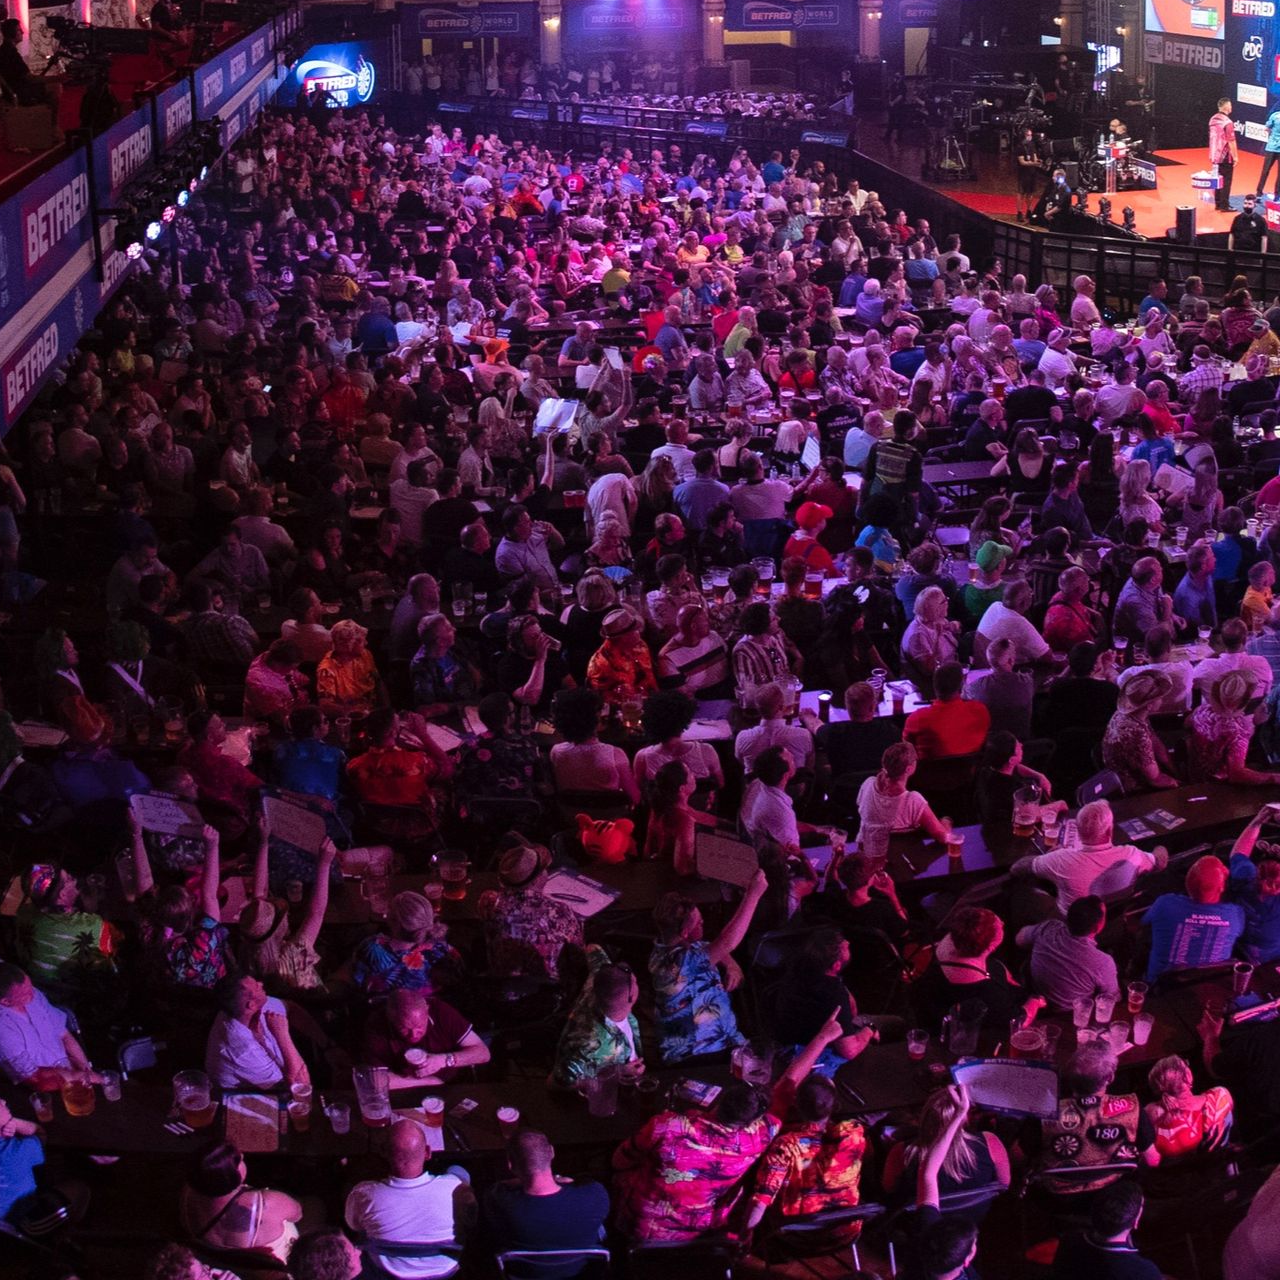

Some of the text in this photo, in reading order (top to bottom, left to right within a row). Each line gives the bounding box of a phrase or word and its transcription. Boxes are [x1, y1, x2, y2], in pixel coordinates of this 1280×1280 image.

[1164, 40, 1222, 69] BETFRED
[305, 75, 357, 94] BTFRED
[27, 172, 90, 268] BETFRED
[6, 321, 59, 415] BETFRED
[1080, 1096, 1098, 1106] 180
[1108, 1099, 1129, 1113] 180
[1095, 1127, 1121, 1140] 180
